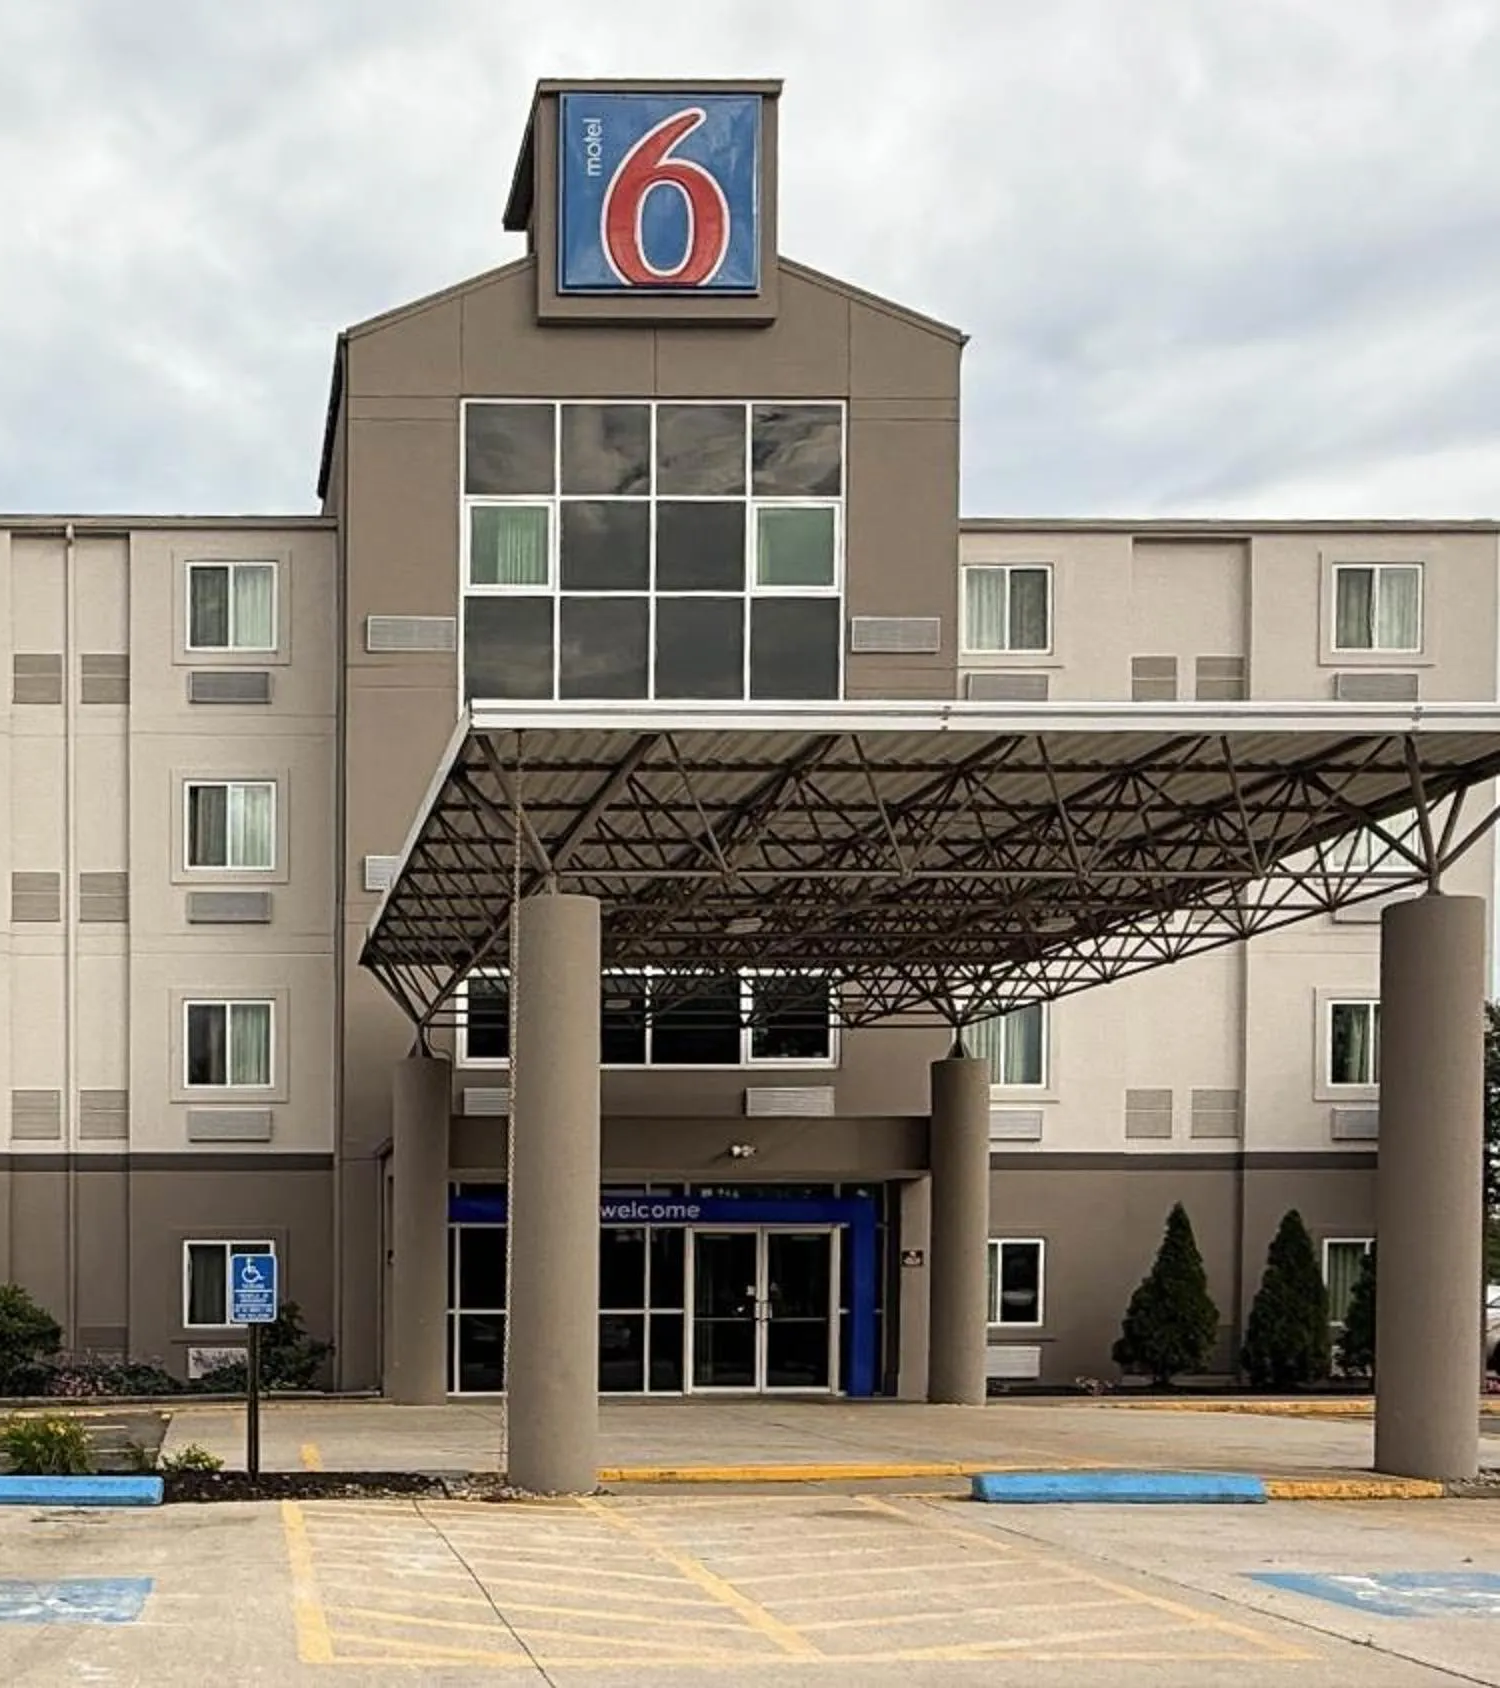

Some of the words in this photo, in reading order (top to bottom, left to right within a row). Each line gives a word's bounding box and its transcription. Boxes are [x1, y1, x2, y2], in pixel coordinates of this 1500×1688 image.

[583, 118, 601, 177] motel
[601, 107, 730, 285] 6
[600, 1200, 701, 1219] welcome
